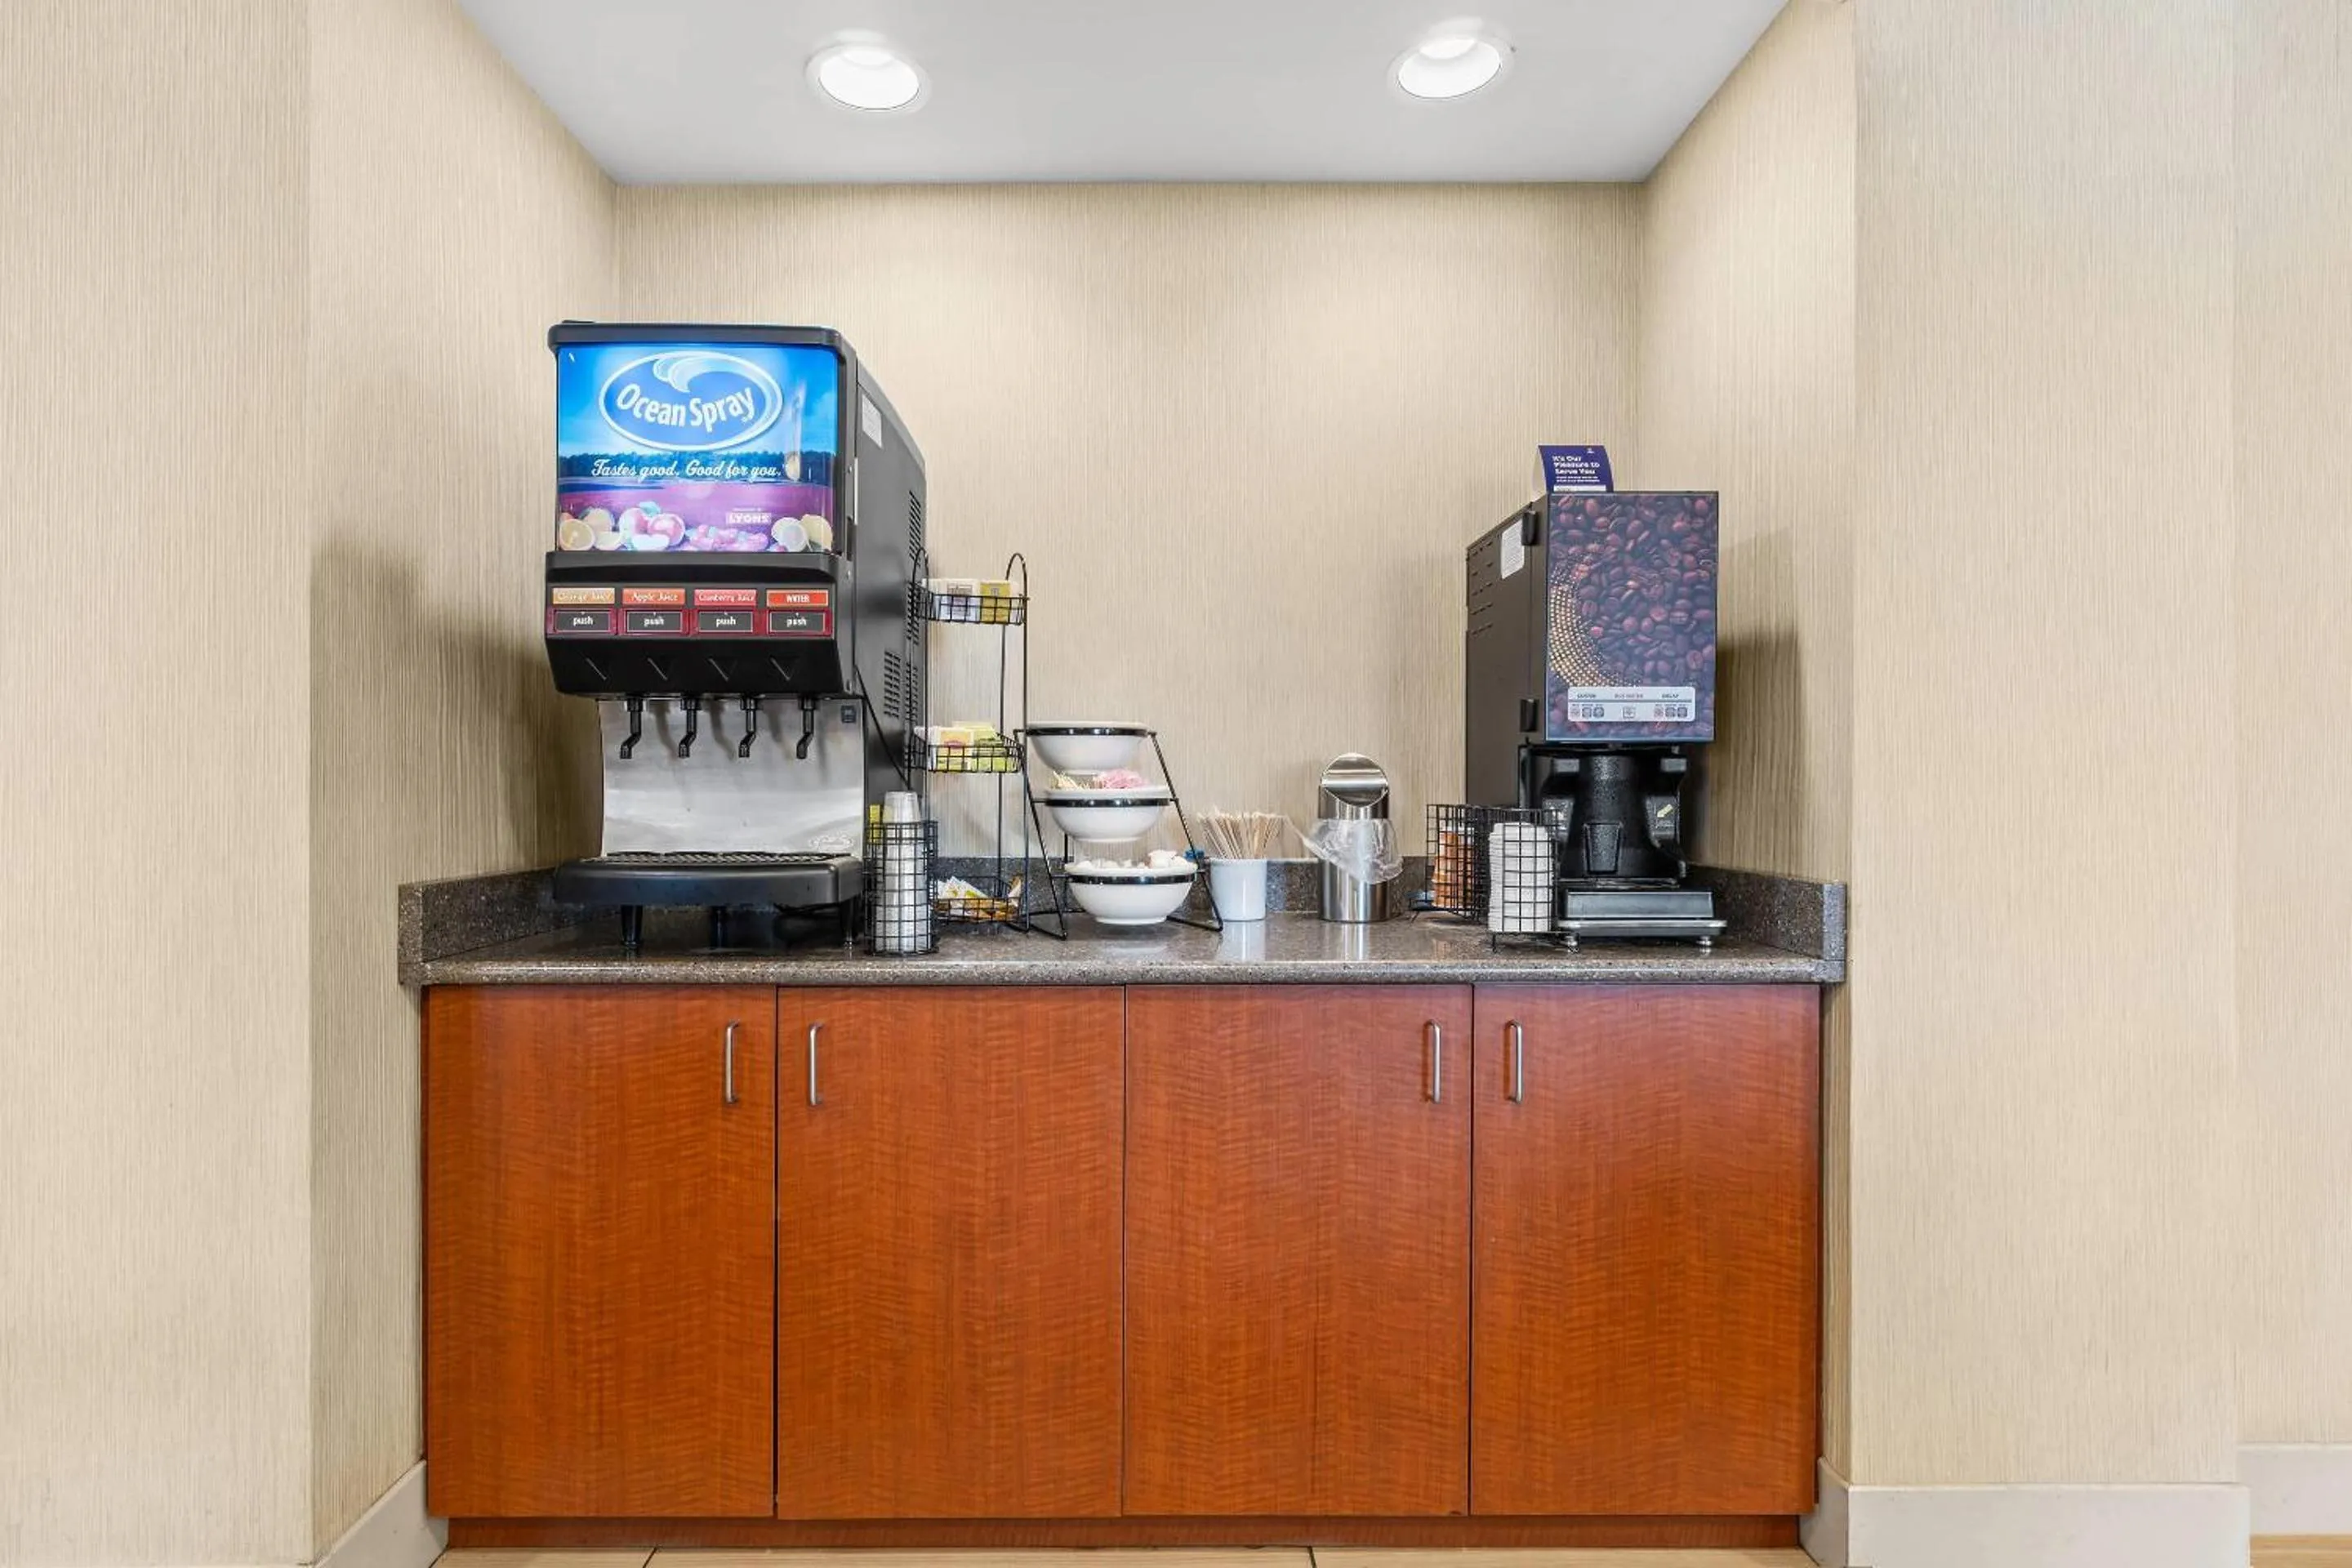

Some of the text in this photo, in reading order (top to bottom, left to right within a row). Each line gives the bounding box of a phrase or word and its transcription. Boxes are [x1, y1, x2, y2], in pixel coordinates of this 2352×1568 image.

[617, 383, 755, 434] Ocean Spray
[591, 458, 782, 483] Tastes good. Good for you.
[573, 616, 594, 626] push
[644, 617, 665, 627] push
[715, 616, 737, 627] push
[786, 617, 807, 627] push
